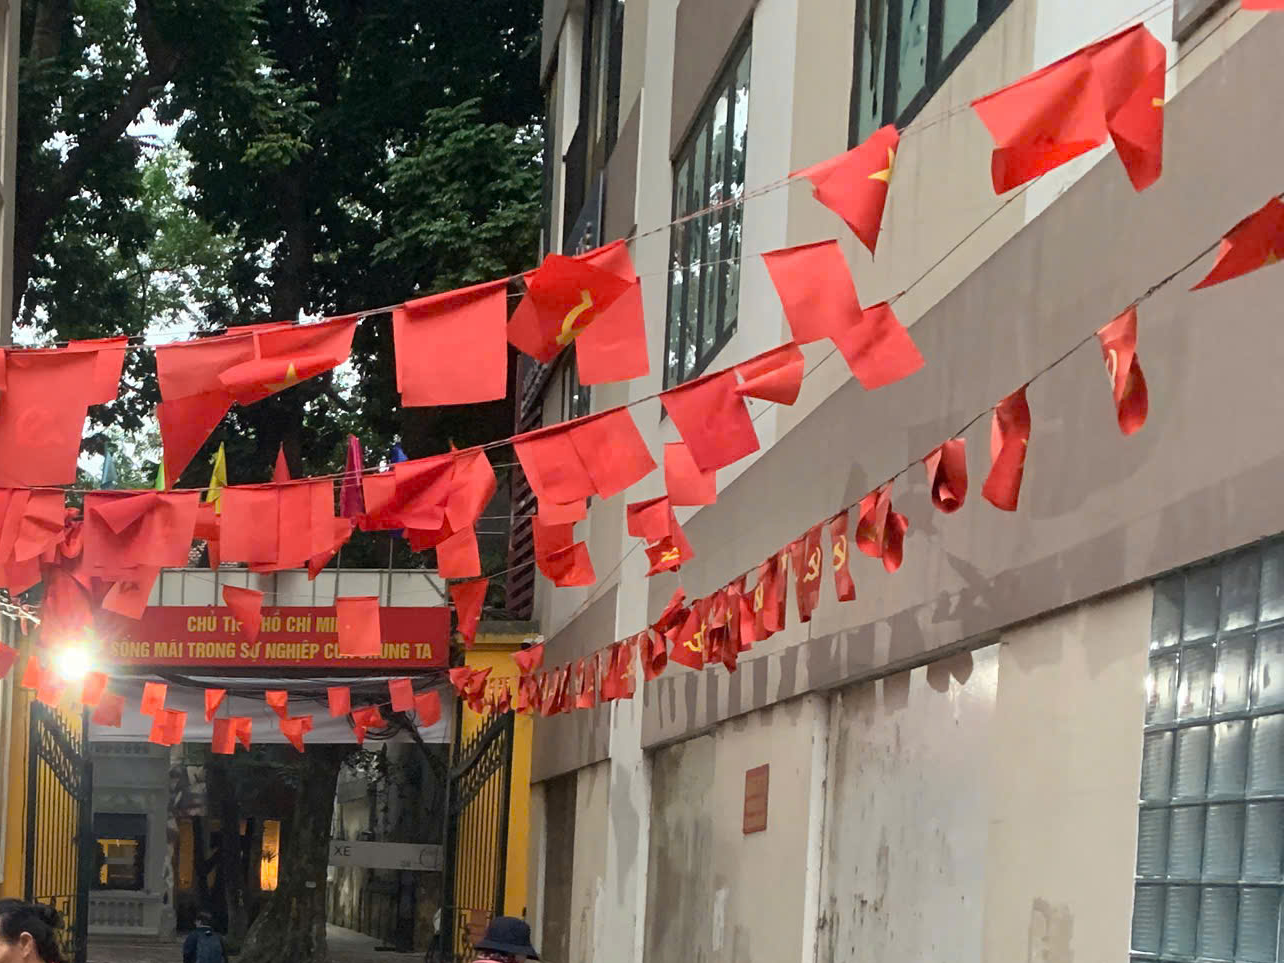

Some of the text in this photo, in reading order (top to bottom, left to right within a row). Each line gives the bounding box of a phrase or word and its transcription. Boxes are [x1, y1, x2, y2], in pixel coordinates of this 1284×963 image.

[187, 610, 217, 632] CHỦ
[286, 612, 312, 632] CHÍ
[154, 639, 183, 658] MÃI
[187, 641, 236, 659] TRONG
[240, 641, 262, 662] SỰ
[265, 639, 320, 663] NGHIỆP
[414, 642, 432, 660] TA
